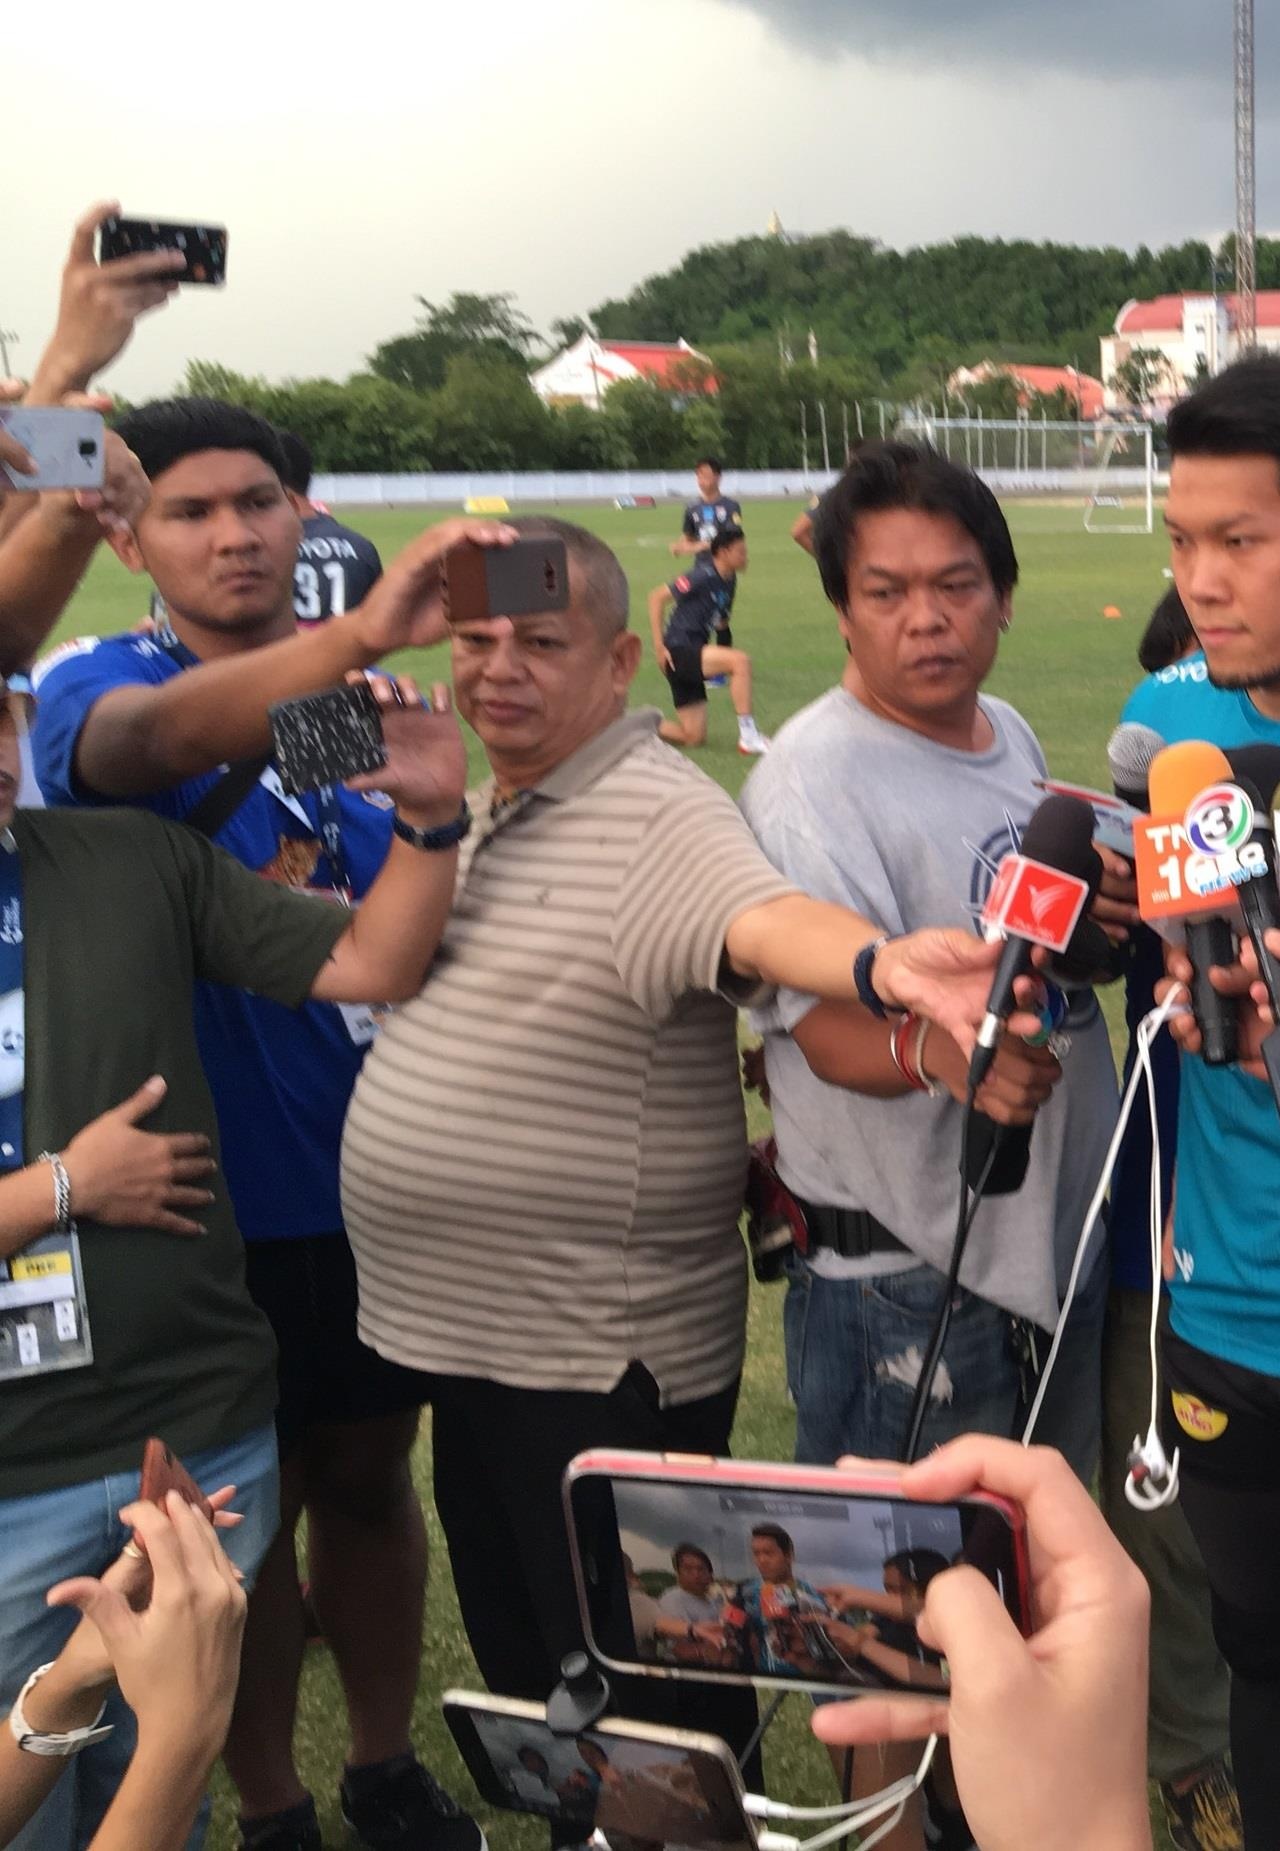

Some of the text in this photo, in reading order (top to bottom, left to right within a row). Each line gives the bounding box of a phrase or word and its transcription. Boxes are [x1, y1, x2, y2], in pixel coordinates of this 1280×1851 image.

[298, 536, 358, 560] YOTA
[293, 561, 345, 618] 31
[1145, 823, 1190, 854] TN
[1201, 804, 1235, 840] 3
